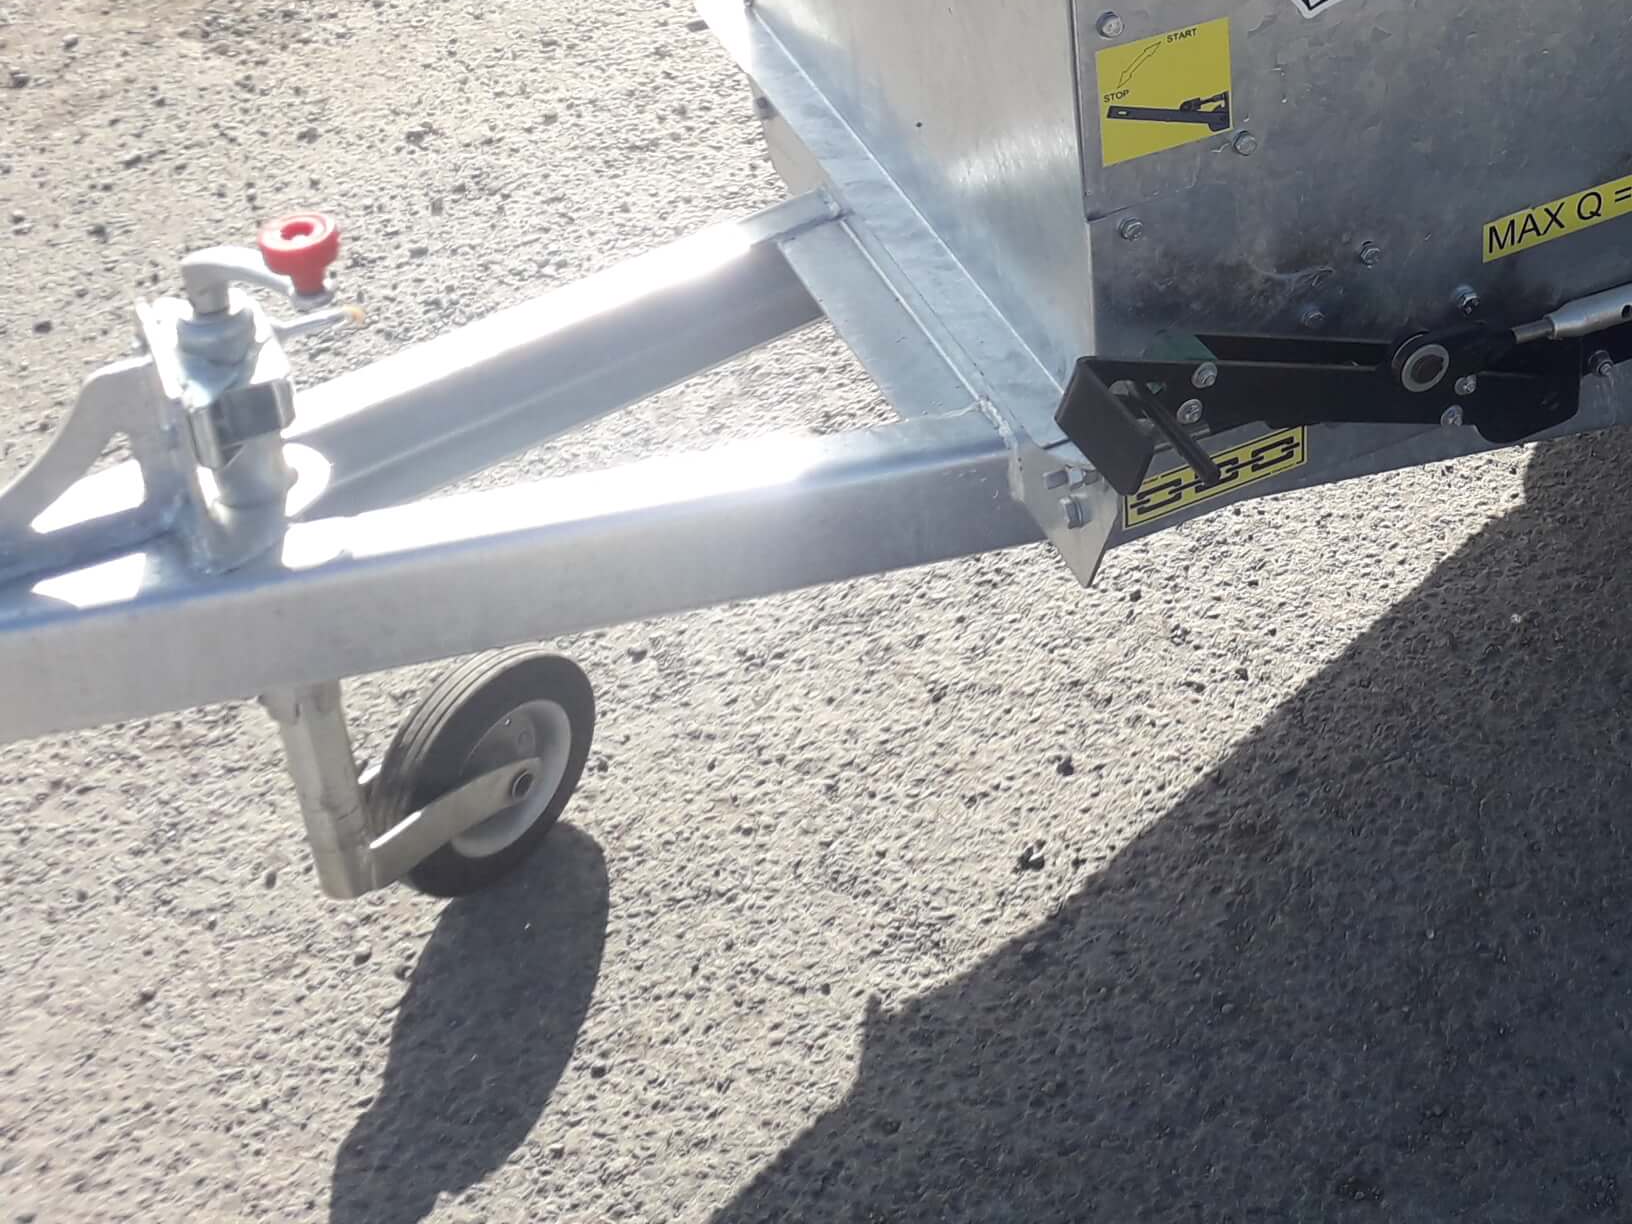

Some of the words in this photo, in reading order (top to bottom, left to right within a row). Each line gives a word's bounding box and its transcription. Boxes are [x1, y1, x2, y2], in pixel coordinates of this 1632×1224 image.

[1166, 28, 1197, 43] START
[1103, 89, 1129, 103] STOP
[1488, 202, 1566, 254] MAX
[1577, 191, 1602, 221] Q
[1614, 186, 1632, 203] =
